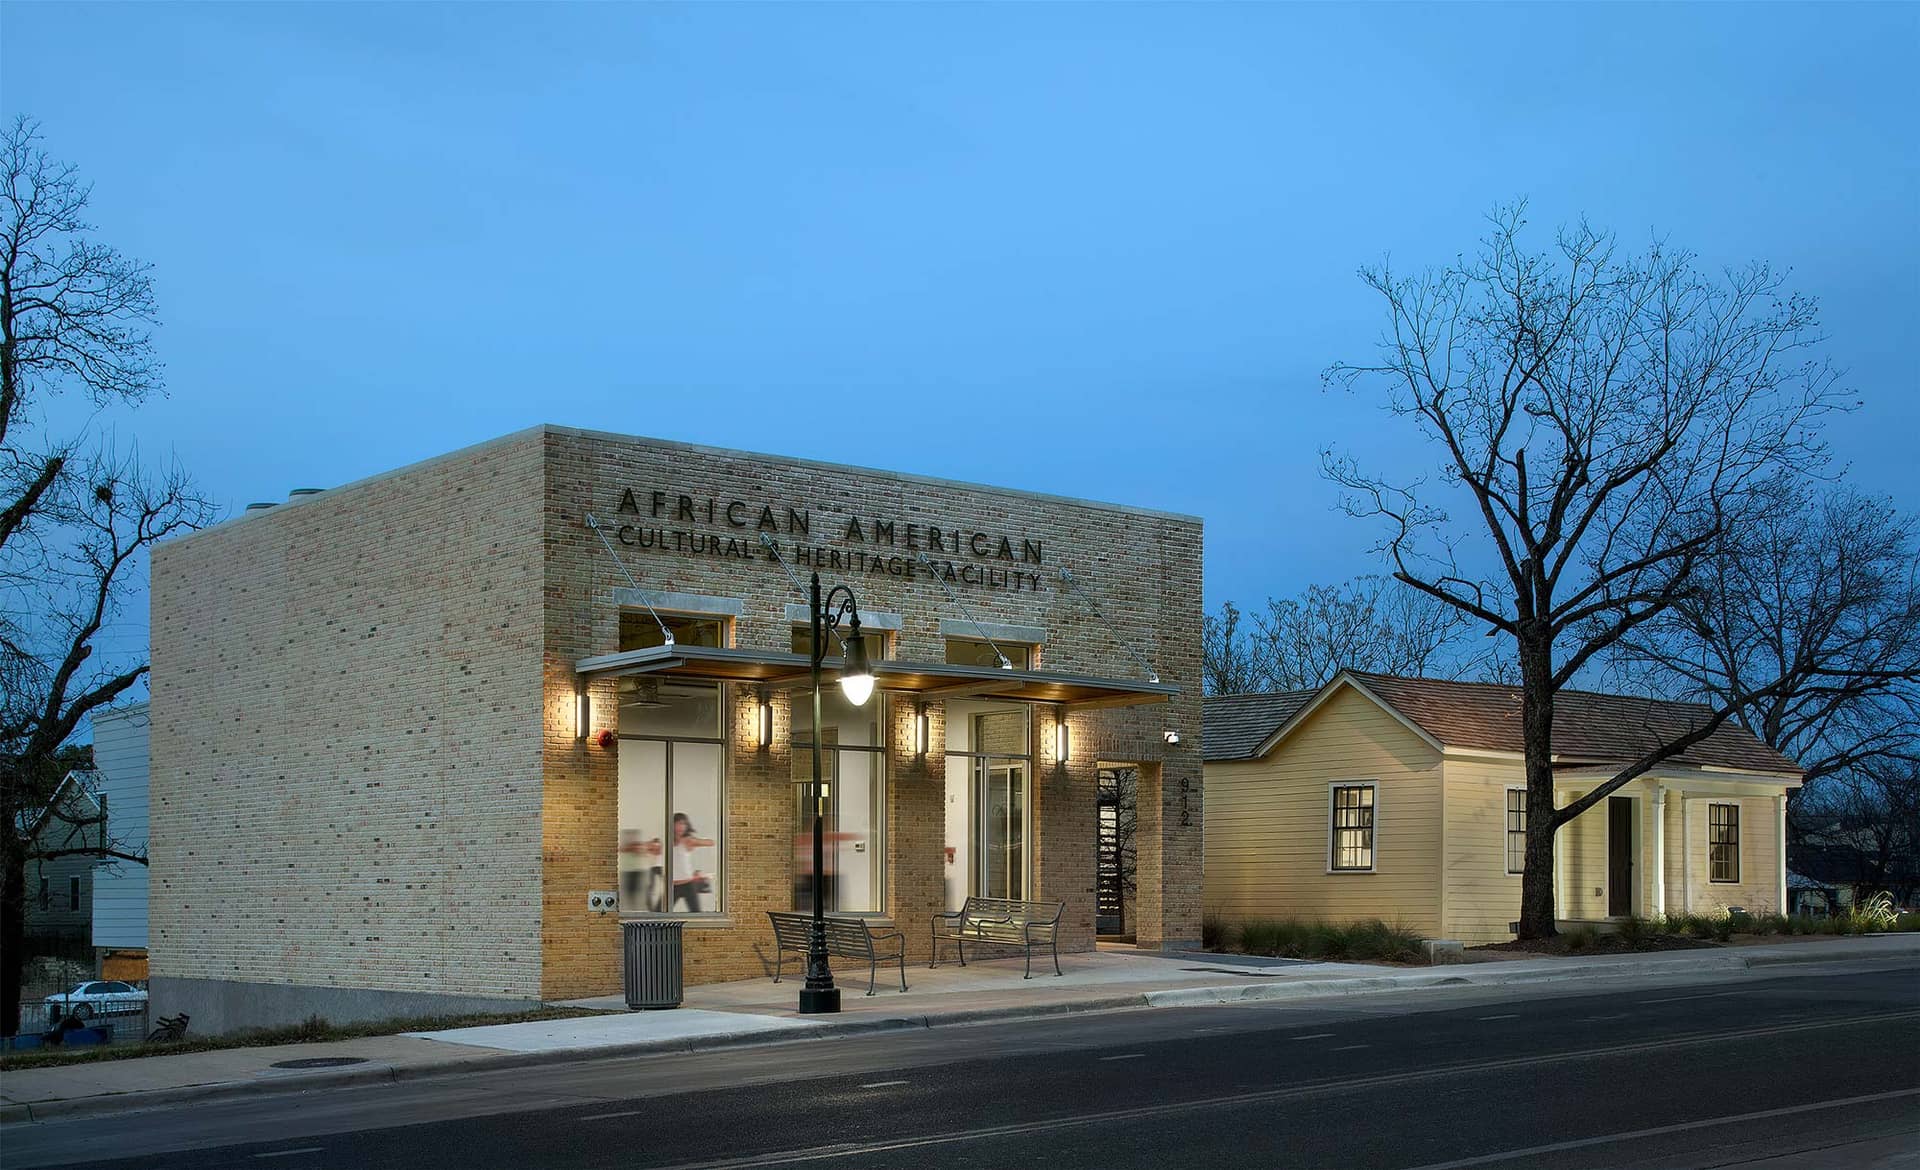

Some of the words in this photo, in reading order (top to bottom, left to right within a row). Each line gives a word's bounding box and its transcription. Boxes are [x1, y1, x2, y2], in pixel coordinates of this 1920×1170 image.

[618, 487, 809, 535] AFRICAN
[847, 515, 1042, 565] AMERICAN
[618, 525, 754, 560] CULTURAL
[768, 538, 782, 562] &
[797, 545, 916, 578] HERITAGE
[929, 560, 1042, 592] FACILITY
